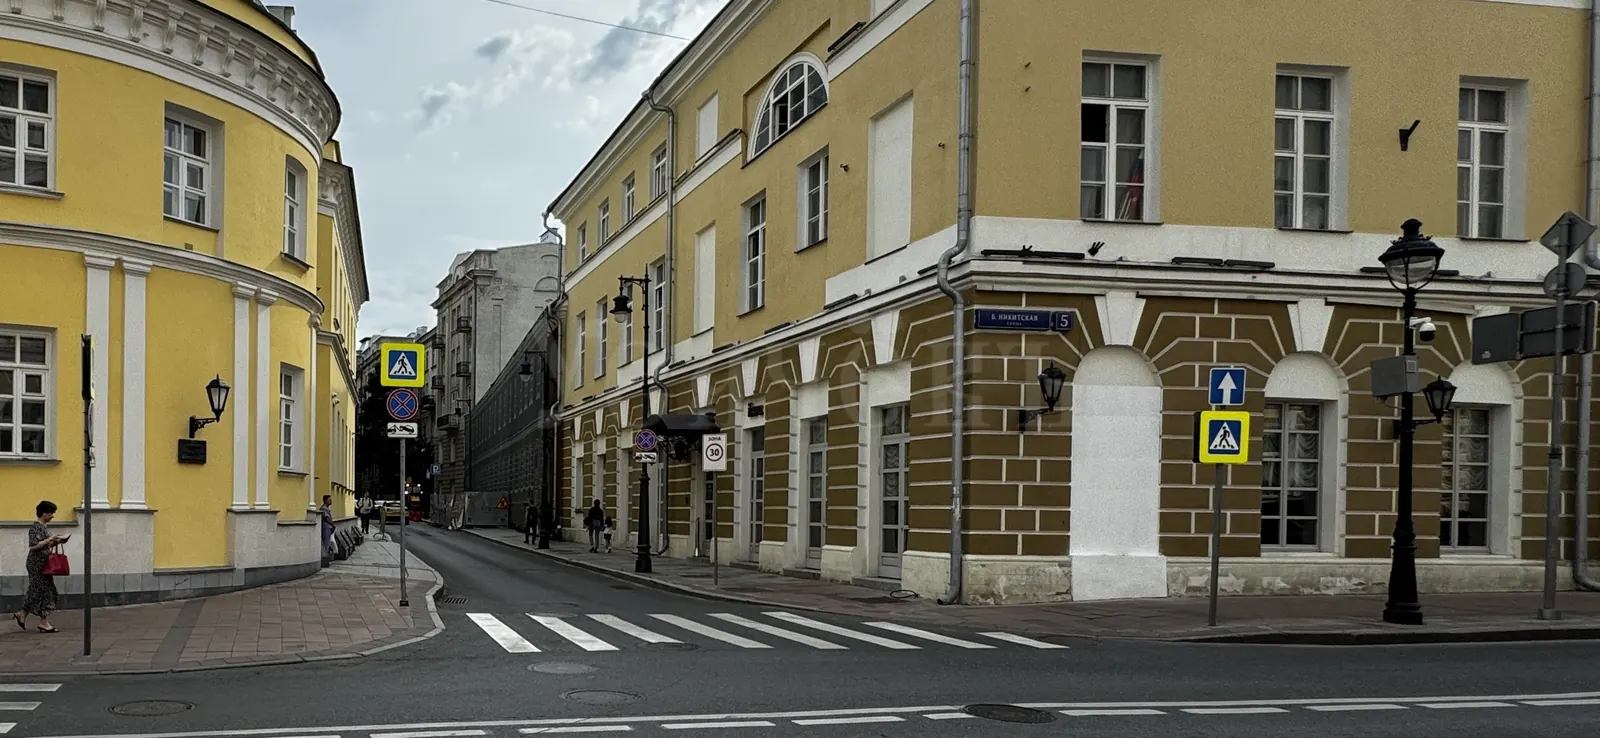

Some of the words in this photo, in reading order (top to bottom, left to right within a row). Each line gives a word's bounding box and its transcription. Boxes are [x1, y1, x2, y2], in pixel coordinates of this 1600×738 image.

[1060, 314, 1069, 327] 5
[709, 448, 720, 456] 30
[433, 465, 439, 473] P
